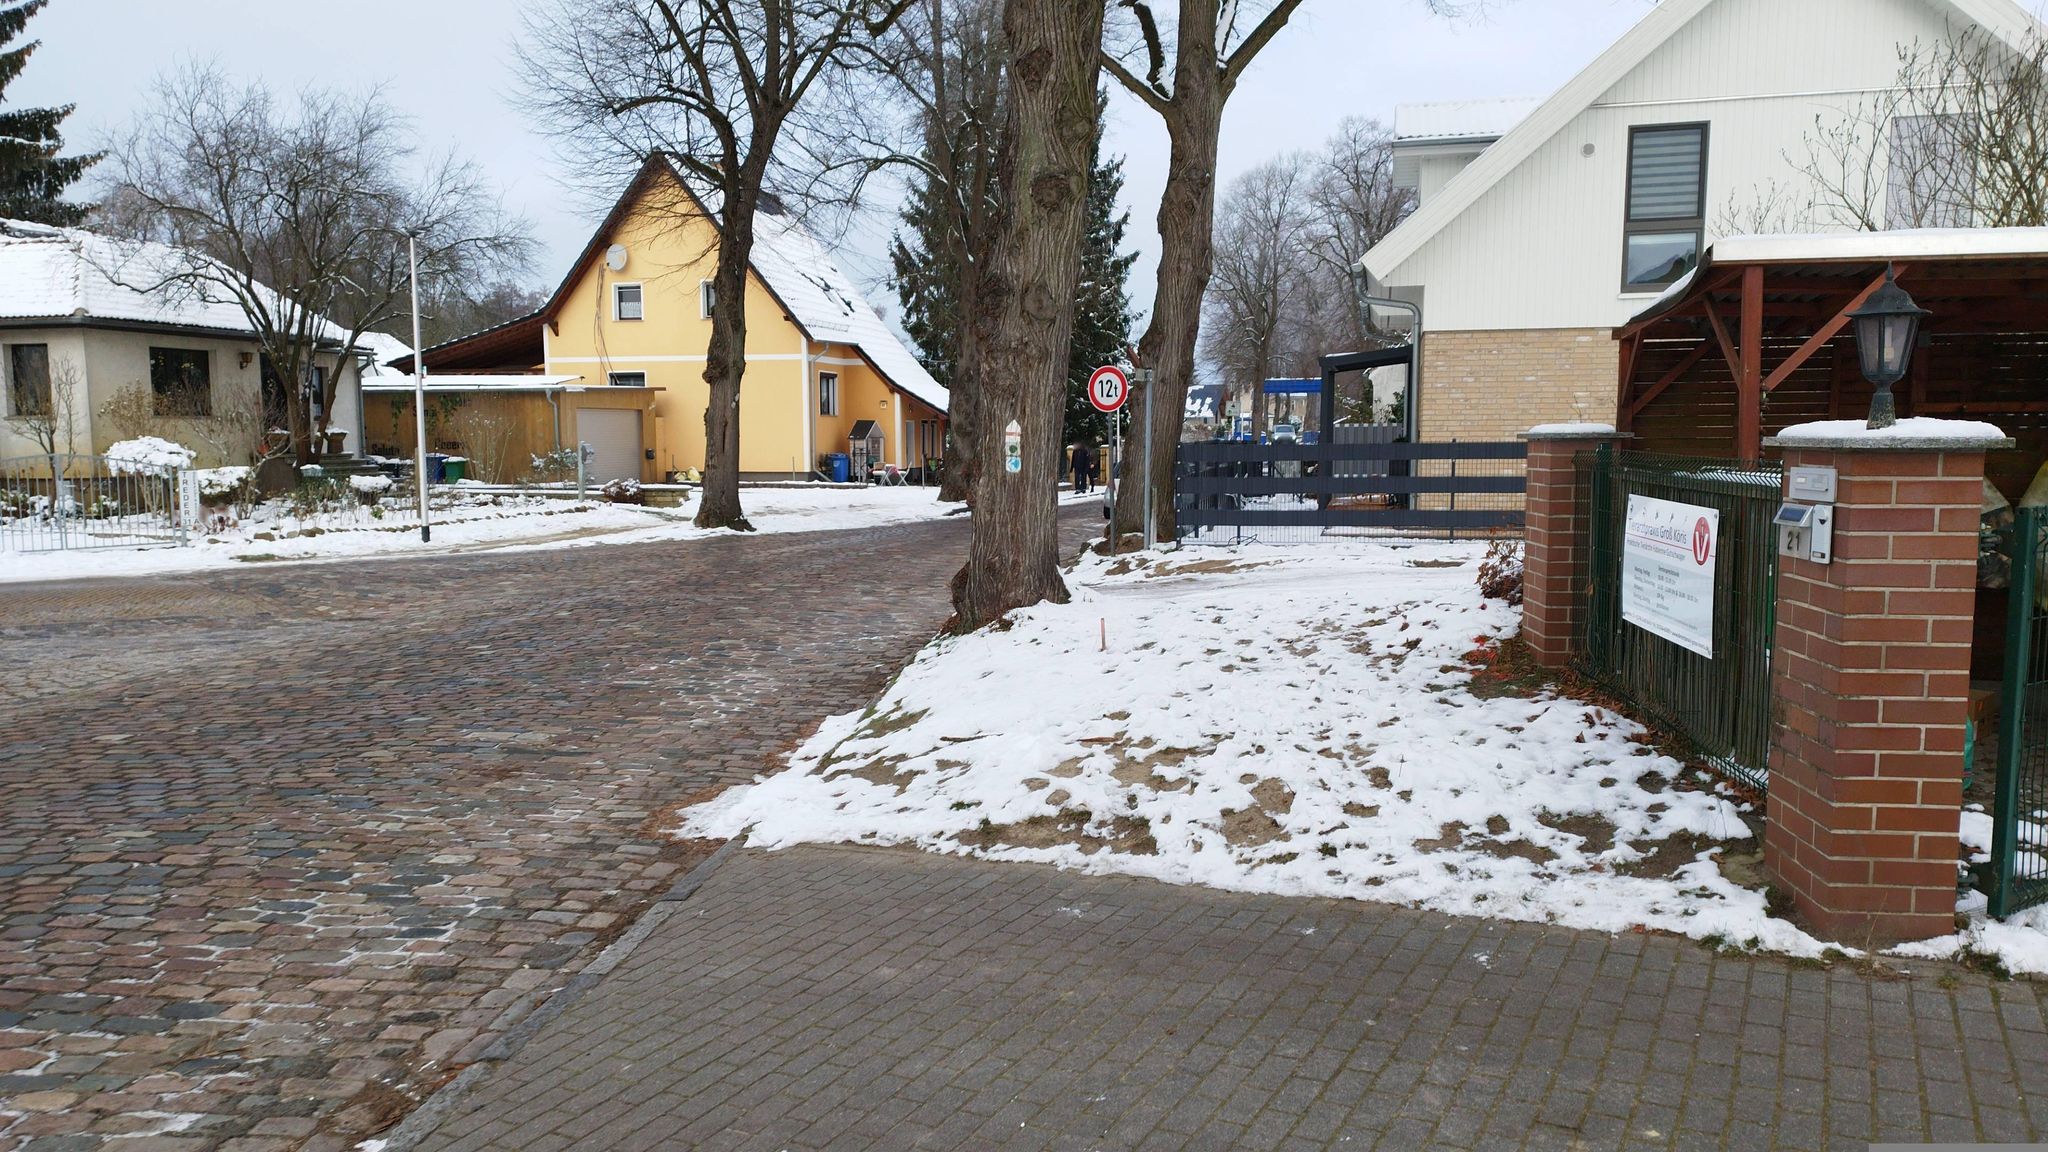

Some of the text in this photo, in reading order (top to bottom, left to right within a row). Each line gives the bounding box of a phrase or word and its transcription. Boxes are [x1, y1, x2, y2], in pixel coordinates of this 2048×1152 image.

[1098, 379, 1118, 398] 12t
[182, 471, 190, 516] TREDER
[1628, 517, 1687, 545] Tierarztpraxis Groß Köris
[1787, 530, 1801, 552] 21
